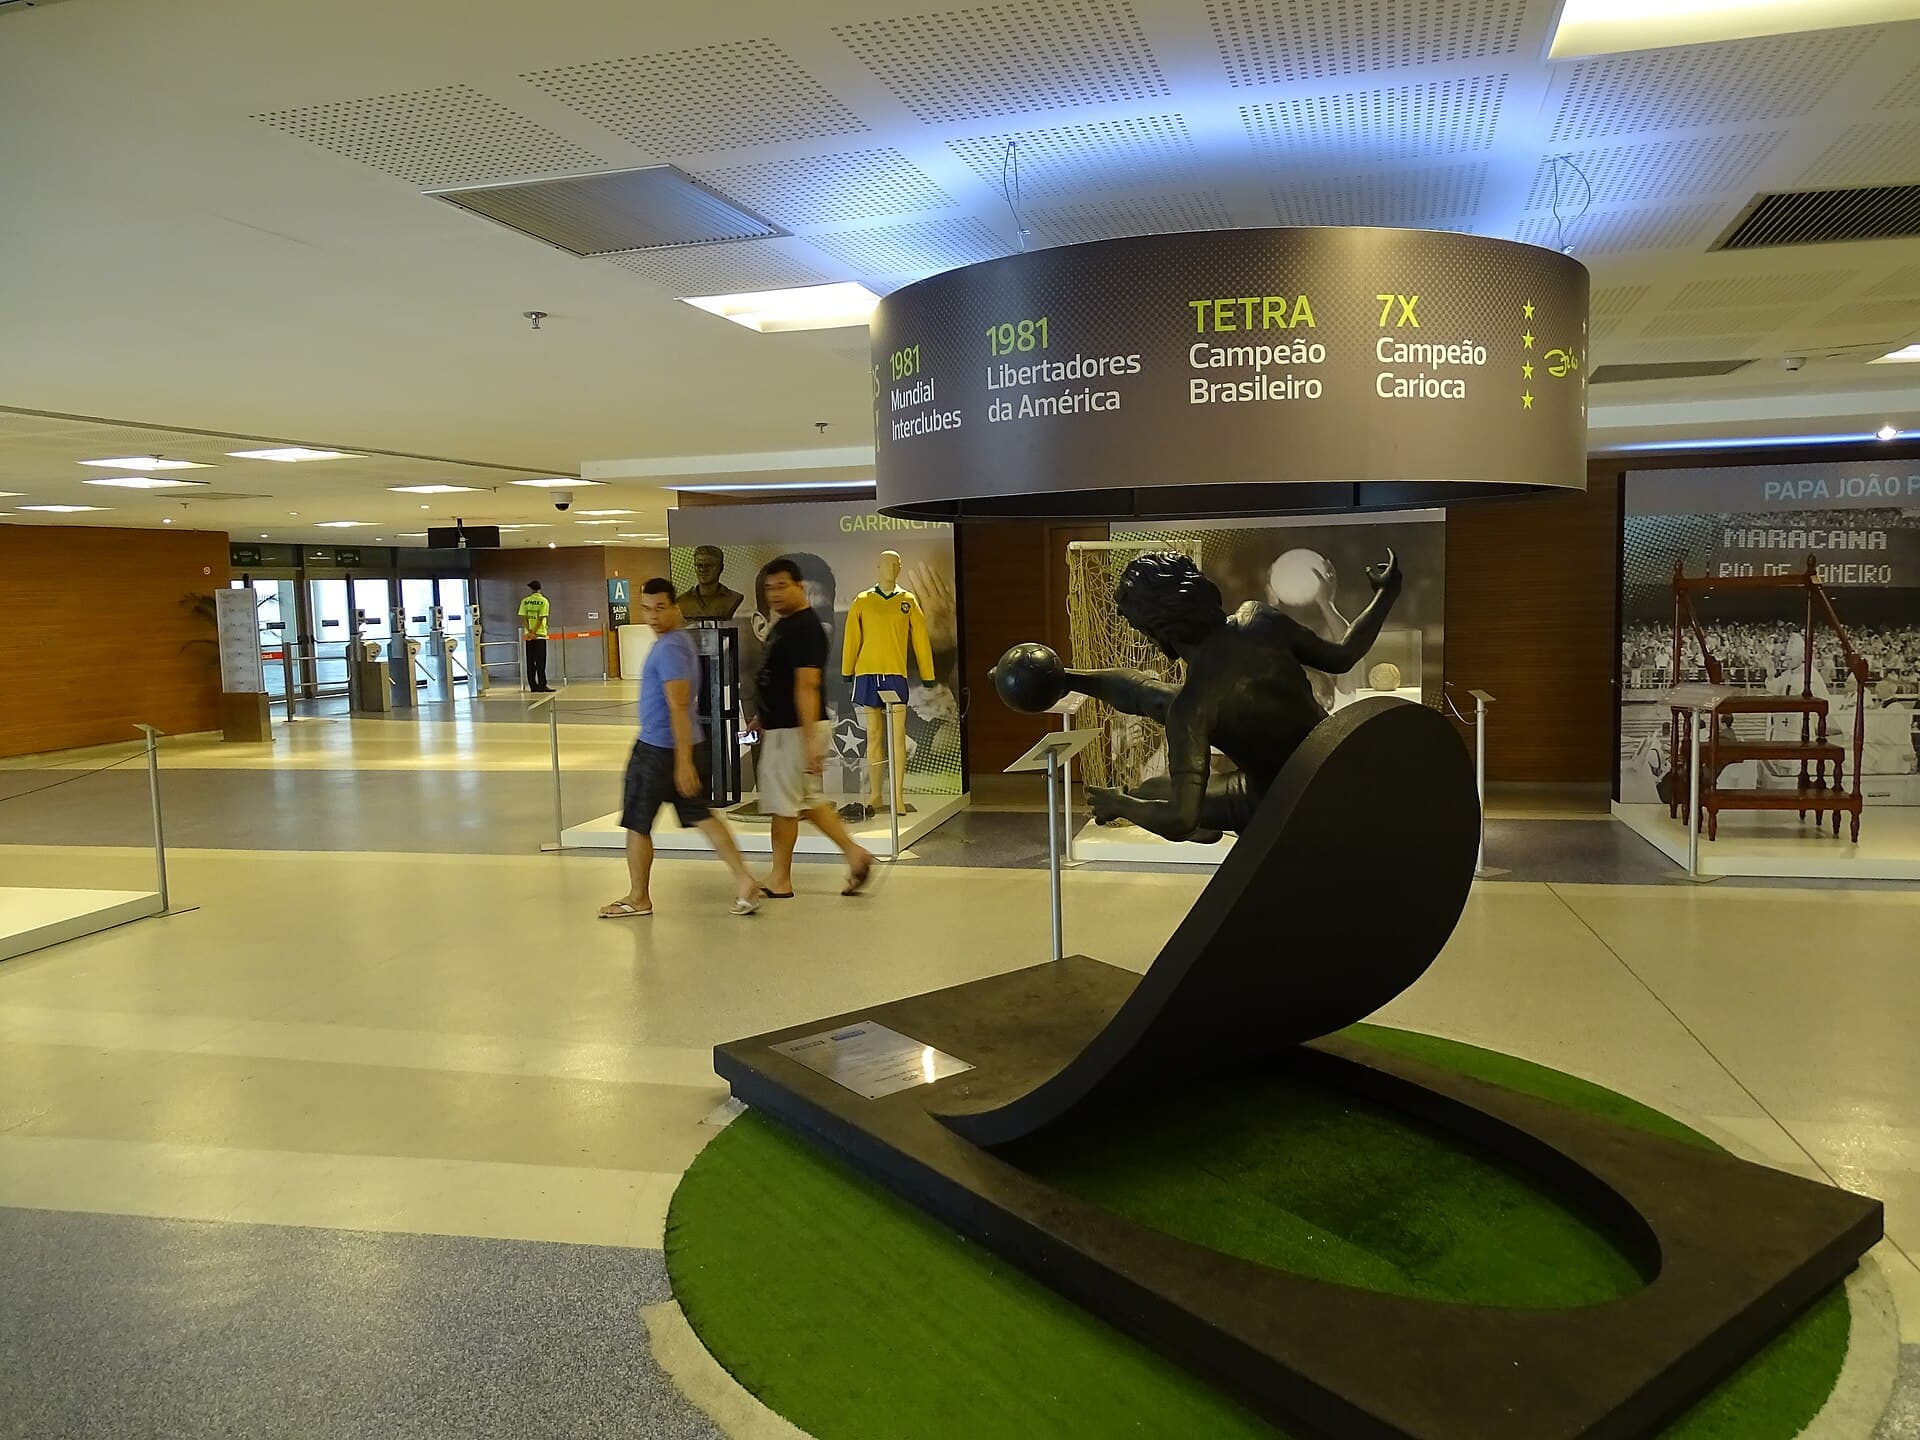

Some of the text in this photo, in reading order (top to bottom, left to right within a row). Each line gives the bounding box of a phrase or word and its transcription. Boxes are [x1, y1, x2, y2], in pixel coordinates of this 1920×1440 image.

[1188, 294, 1317, 334] TETRA
[1375, 294, 1421, 328] 7X
[985, 316, 1049, 357] 1981
[1375, 336, 1488, 371] Campeão
[889, 343, 920, 382] 1981
[986, 353, 1142, 390] Libertadores
[1189, 338, 1327, 373] Campeão
[890, 377, 935, 412] Mundial
[1189, 374, 1323, 404] Brasileiro
[1375, 372, 1466, 399] Carioca
[987, 386, 1121, 423] da América
[891, 408, 962, 441] Interclubes
[1764, 479, 1830, 500] PAPA
[1836, 474, 1900, 498] JOÃO
[615, 581, 625, 600] A
[1719, 562, 1892, 584] RIO DE ANEIRO
